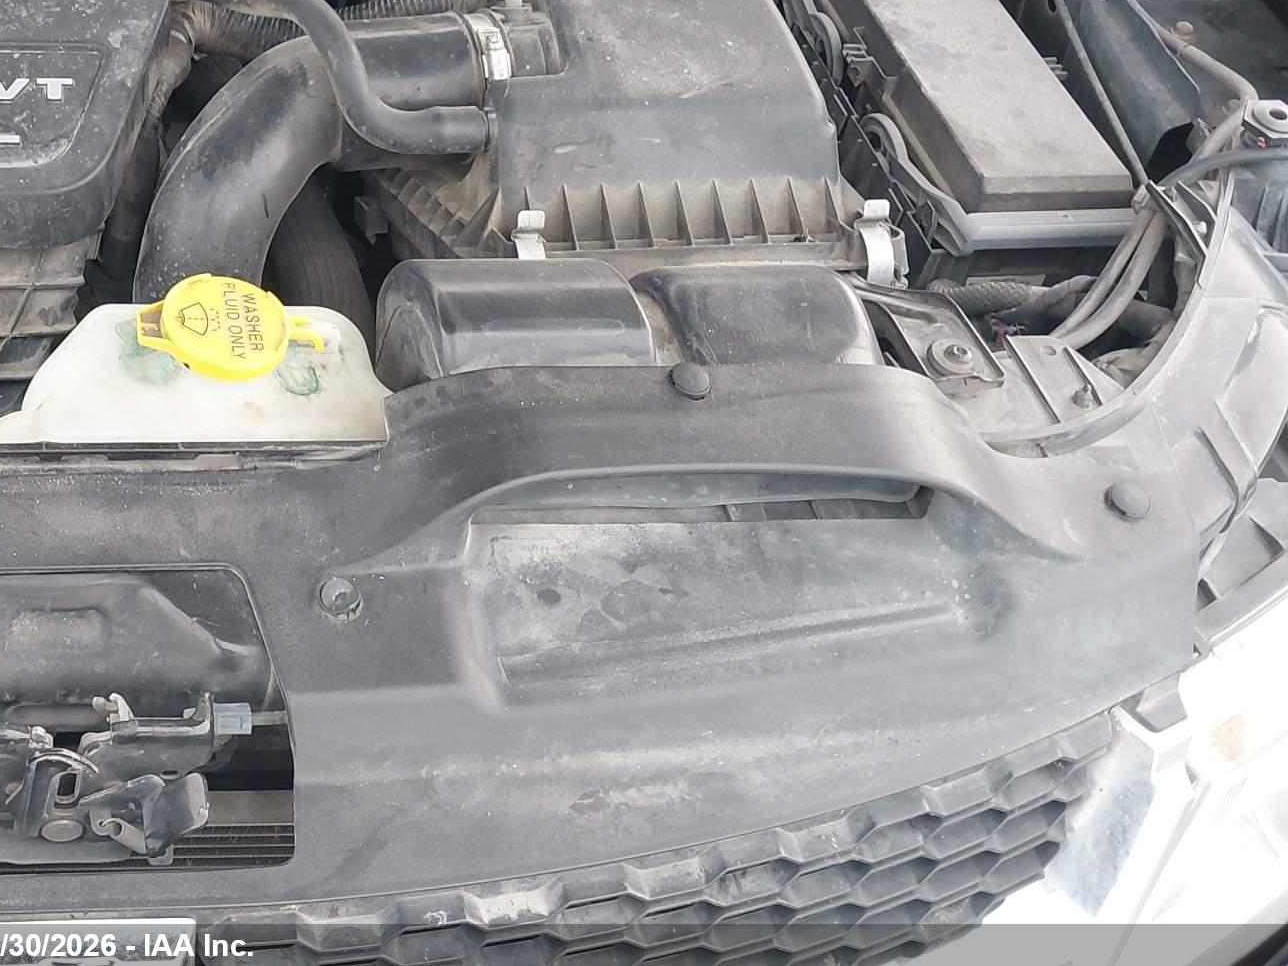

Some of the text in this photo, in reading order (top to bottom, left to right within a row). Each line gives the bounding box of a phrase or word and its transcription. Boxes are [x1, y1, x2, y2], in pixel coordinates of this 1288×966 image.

[222, 282, 249, 360] FLUID ONLY
[241, 292, 265, 352] WASHER
